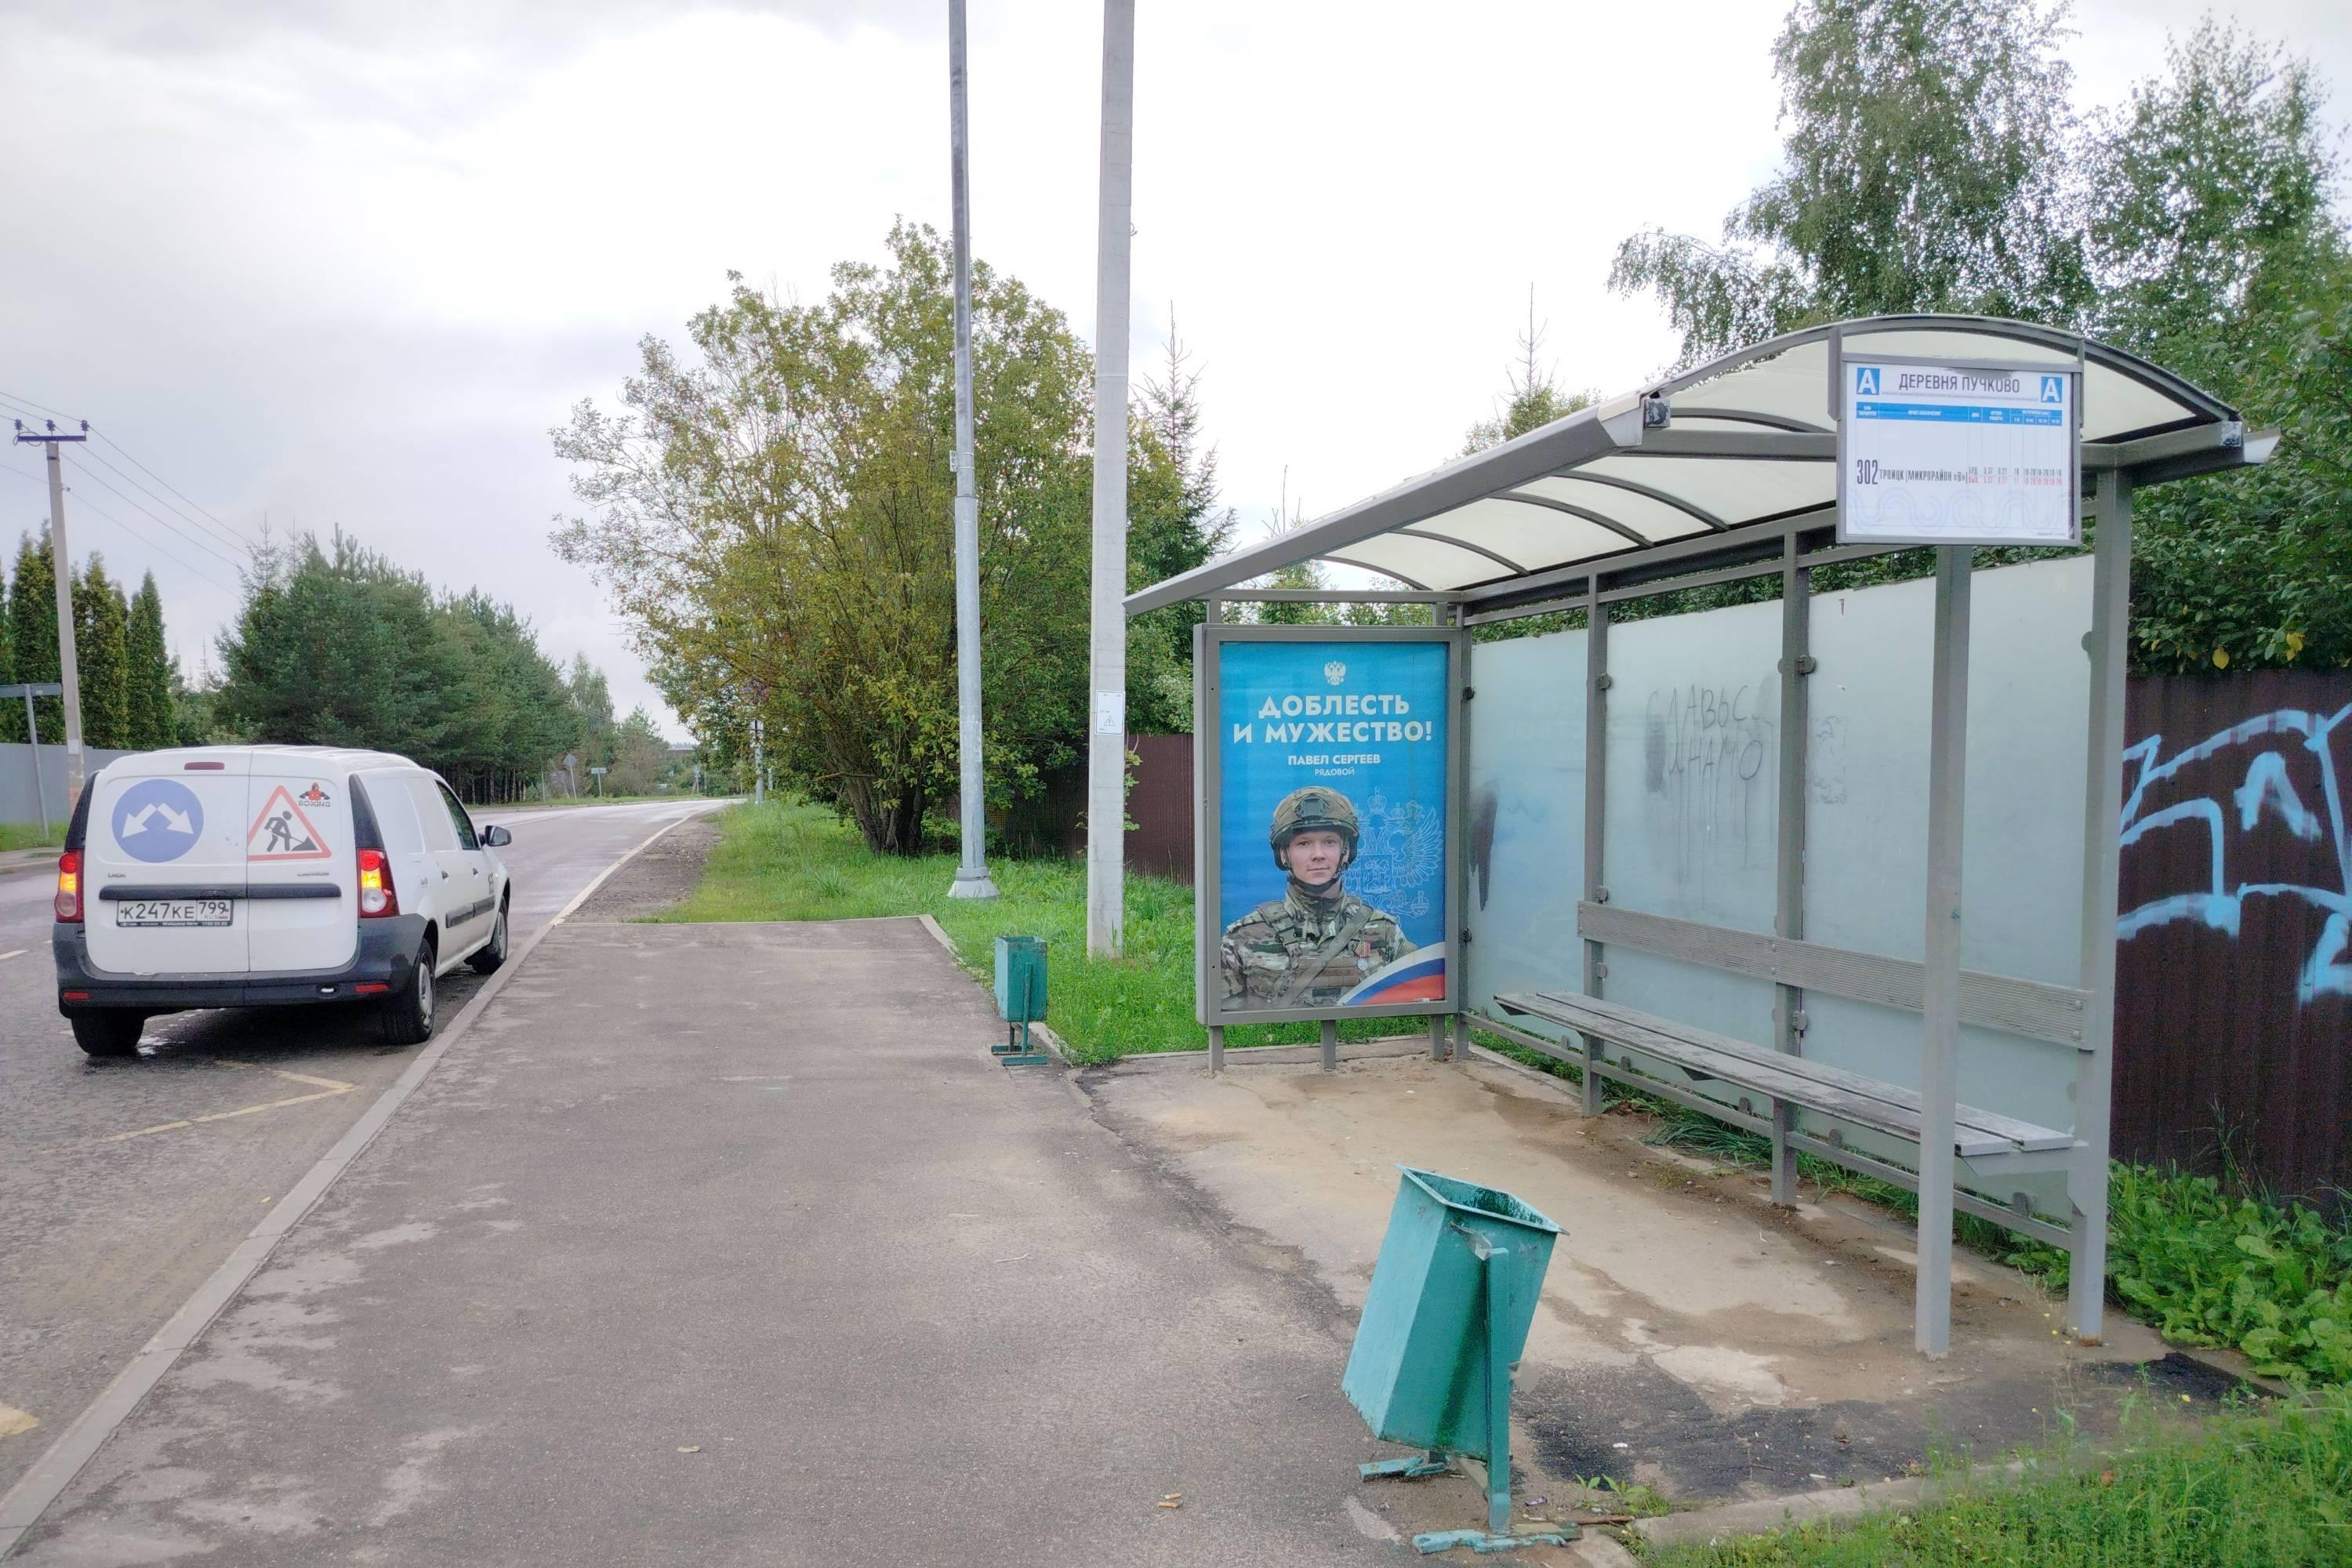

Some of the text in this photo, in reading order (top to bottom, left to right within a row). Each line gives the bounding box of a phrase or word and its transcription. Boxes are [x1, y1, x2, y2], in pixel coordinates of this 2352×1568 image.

[1899, 374, 2020, 393] ДЕРЕВНЯ ПУЧКОВО
[1857, 459, 1878, 485] 302
[1879, 469, 1904, 481] ТРОИЦК
[1258, 695, 1410, 719] ДОБЛЕСТЬ
[1233, 720, 1432, 744] И МУЖЕСТВО!
[1288, 753, 1381, 765] ПАВЕЛ СЕРГЕЕВ
[1314, 766, 1355, 777] РЯДОВОЙ
[198, 902, 227, 914] 799
